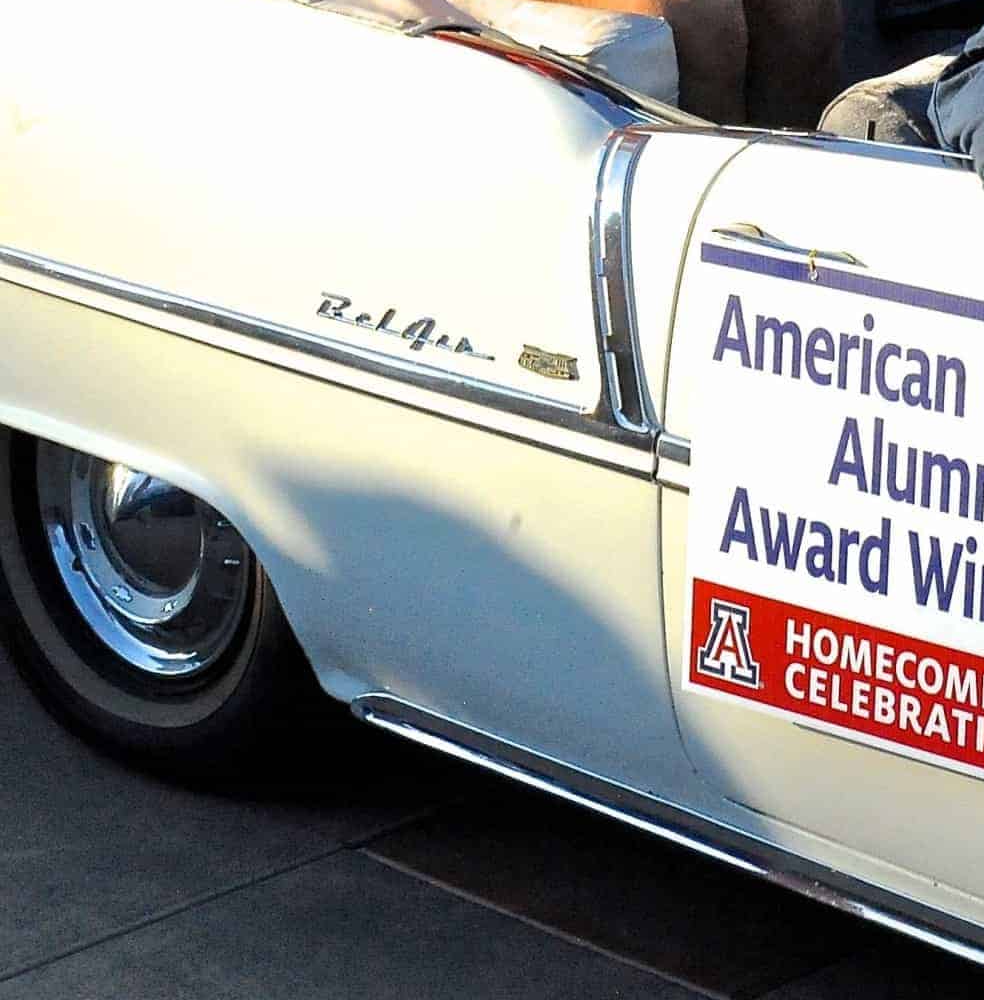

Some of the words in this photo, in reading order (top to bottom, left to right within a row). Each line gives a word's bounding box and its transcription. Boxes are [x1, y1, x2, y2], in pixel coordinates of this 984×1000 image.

[712, 294, 968, 418] American
[719, 486, 892, 597] Award
[697, 598, 760, 689] A
